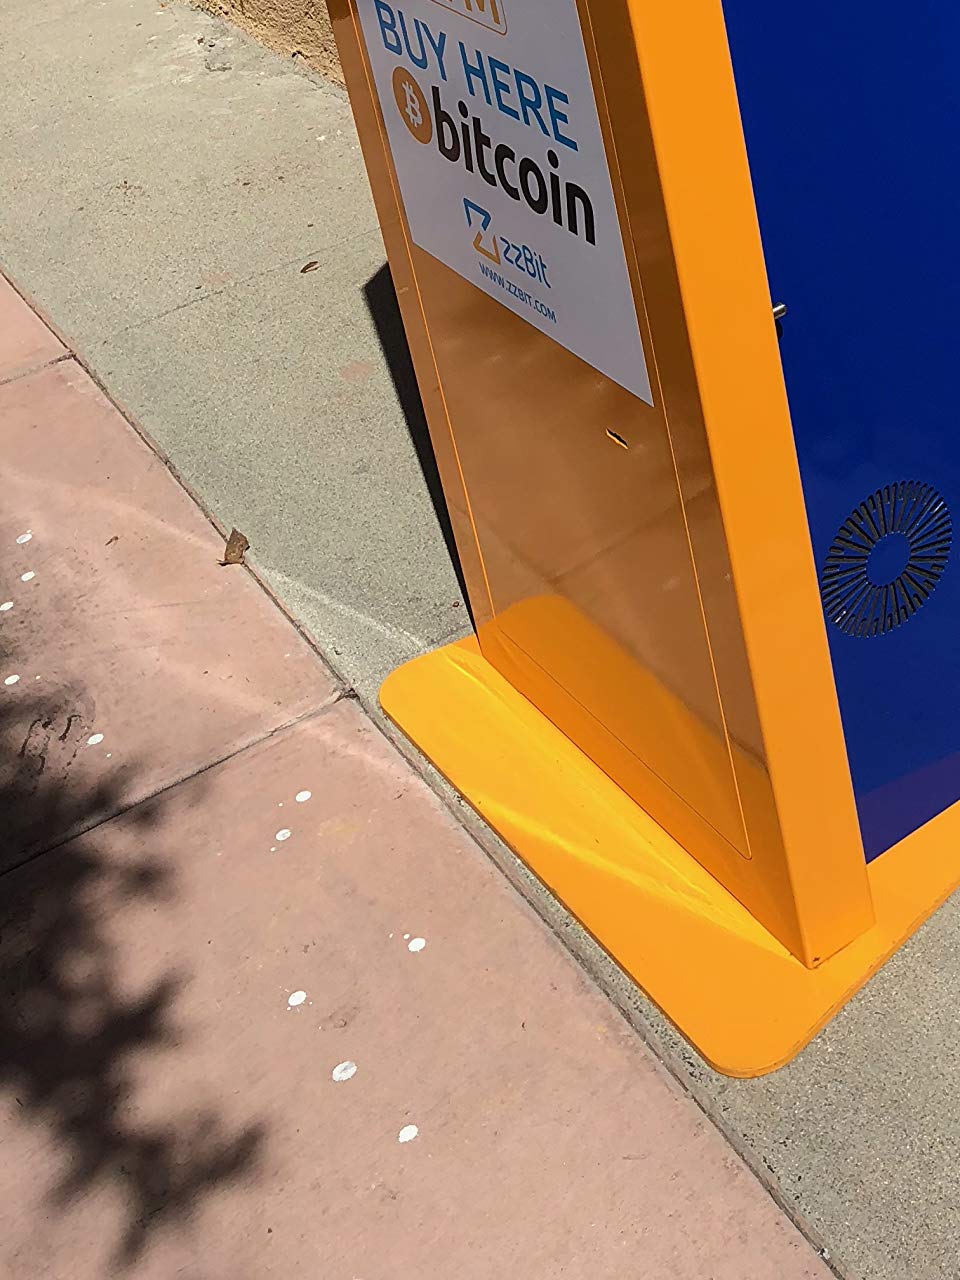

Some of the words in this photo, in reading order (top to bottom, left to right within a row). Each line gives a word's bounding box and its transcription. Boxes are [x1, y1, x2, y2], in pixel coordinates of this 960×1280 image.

[458, 41, 579, 152] HERE
[431, 85, 596, 246] bitcoin
[478, 261, 557, 324] WWW.ZZBIT.COM
